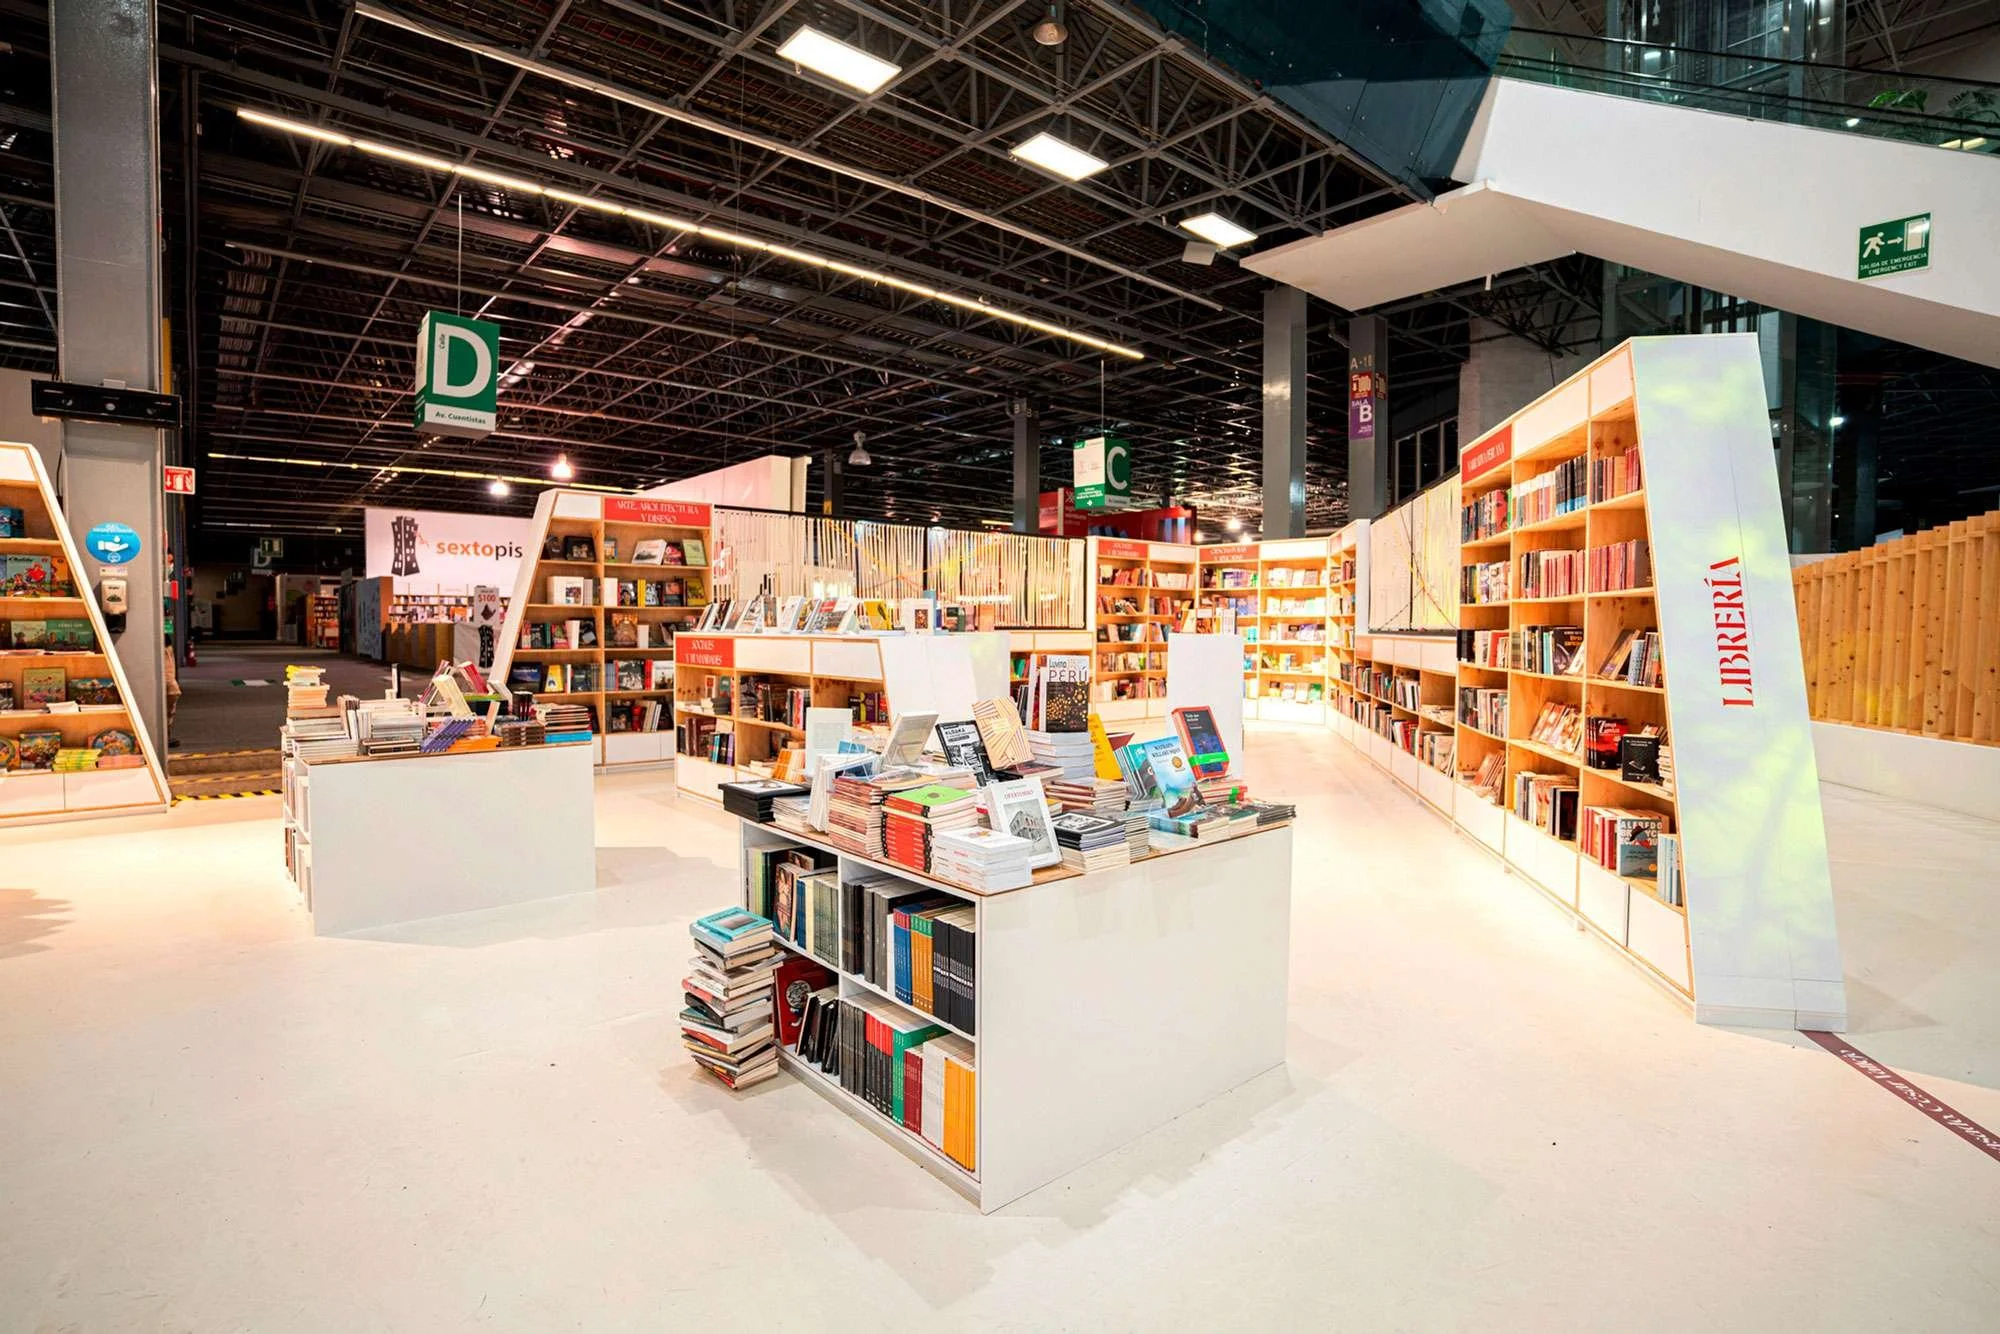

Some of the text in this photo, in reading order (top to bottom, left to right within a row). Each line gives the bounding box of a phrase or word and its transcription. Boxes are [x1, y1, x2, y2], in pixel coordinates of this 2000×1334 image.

[1860, 262, 1880, 271] SALIDA
[1890, 253, 1927, 264] EMERGENCIA
[1868, 261, 1918, 275] EMERGENCY EXIT
[432, 322, 492, 398] D
[448, 412, 486, 424] Cuentistas
[1359, 404, 1373, 423] B
[1106, 446, 1128, 490] C
[640, 502, 699, 514] ARQUITECTURA
[1704, 556, 1754, 708] LIBRERÍA
[1049, 666, 1088, 682] PERÚ
[1621, 821, 1662, 829] ALFREDO
